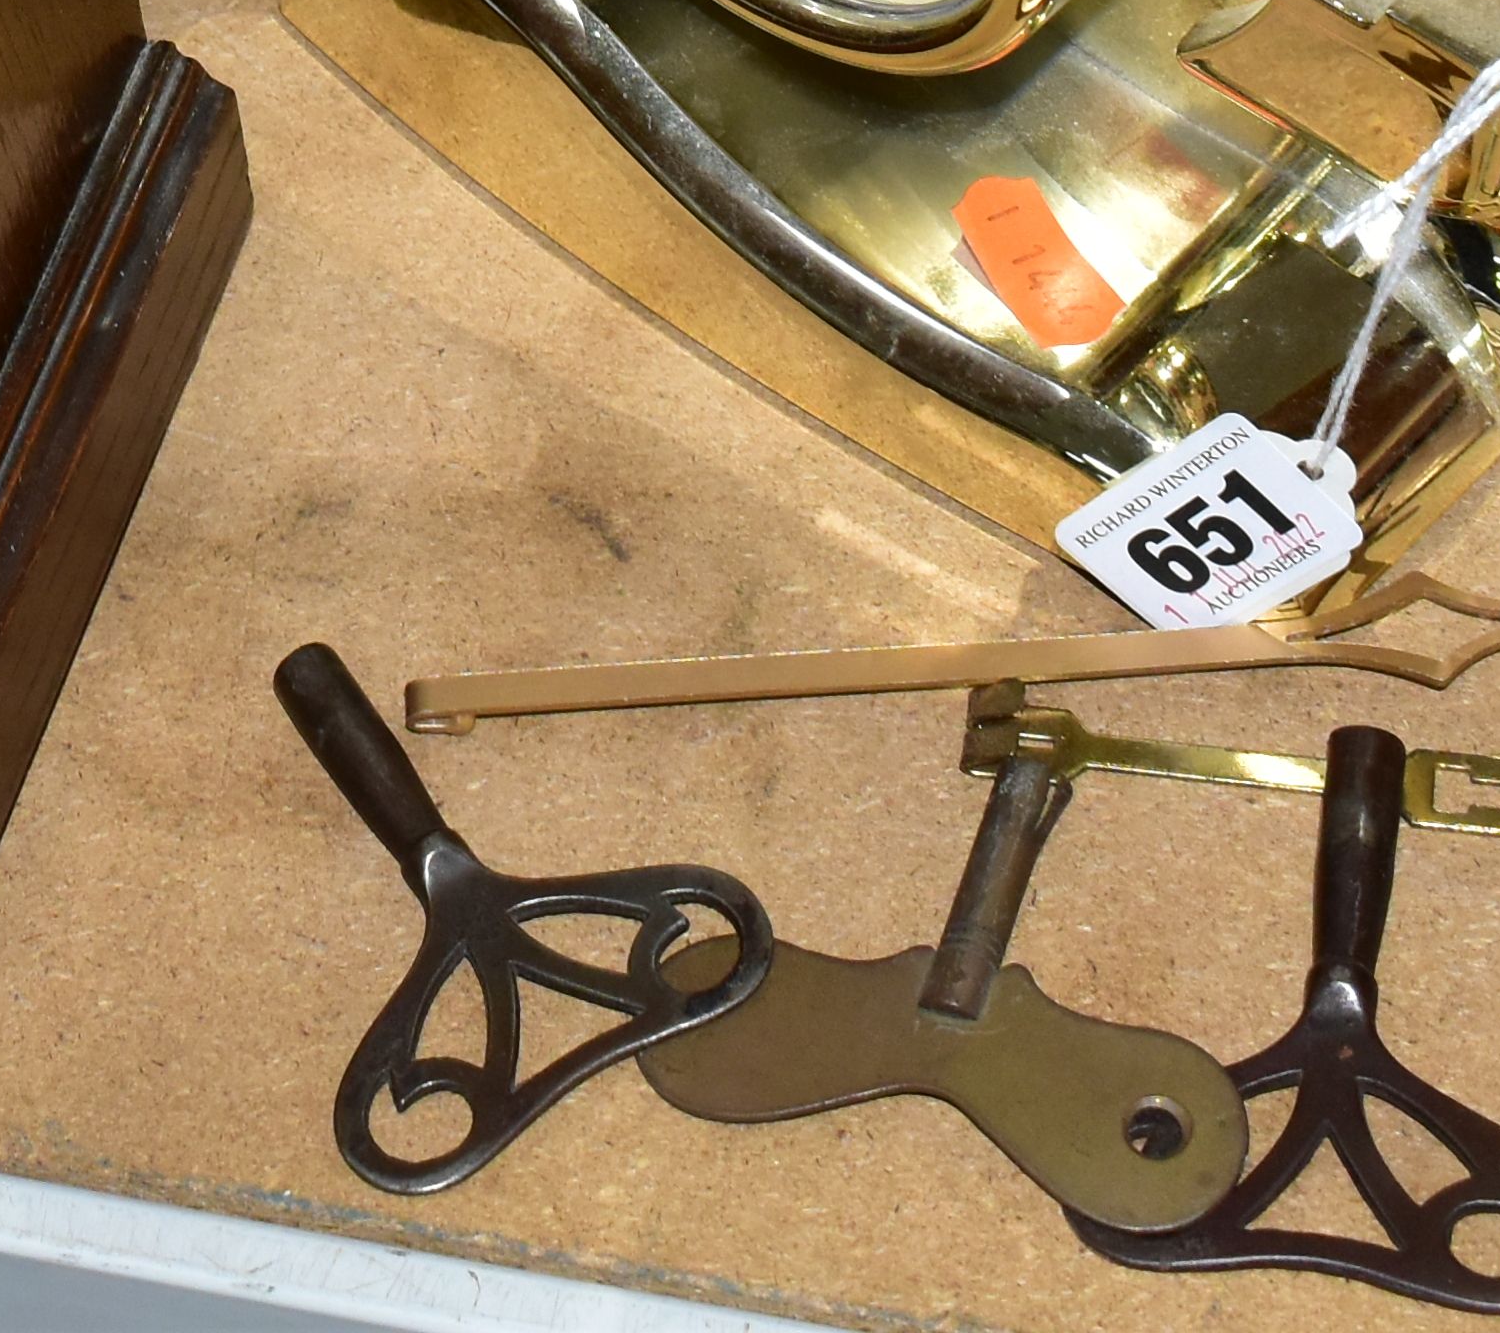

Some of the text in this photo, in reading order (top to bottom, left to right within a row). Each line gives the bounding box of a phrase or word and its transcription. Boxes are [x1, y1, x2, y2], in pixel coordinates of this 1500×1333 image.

[1075, 426, 1252, 550] RICHARD WINTERTON
[1127, 469, 1297, 594] 651
[1206, 539, 1321, 616] AUCTIONEERS
